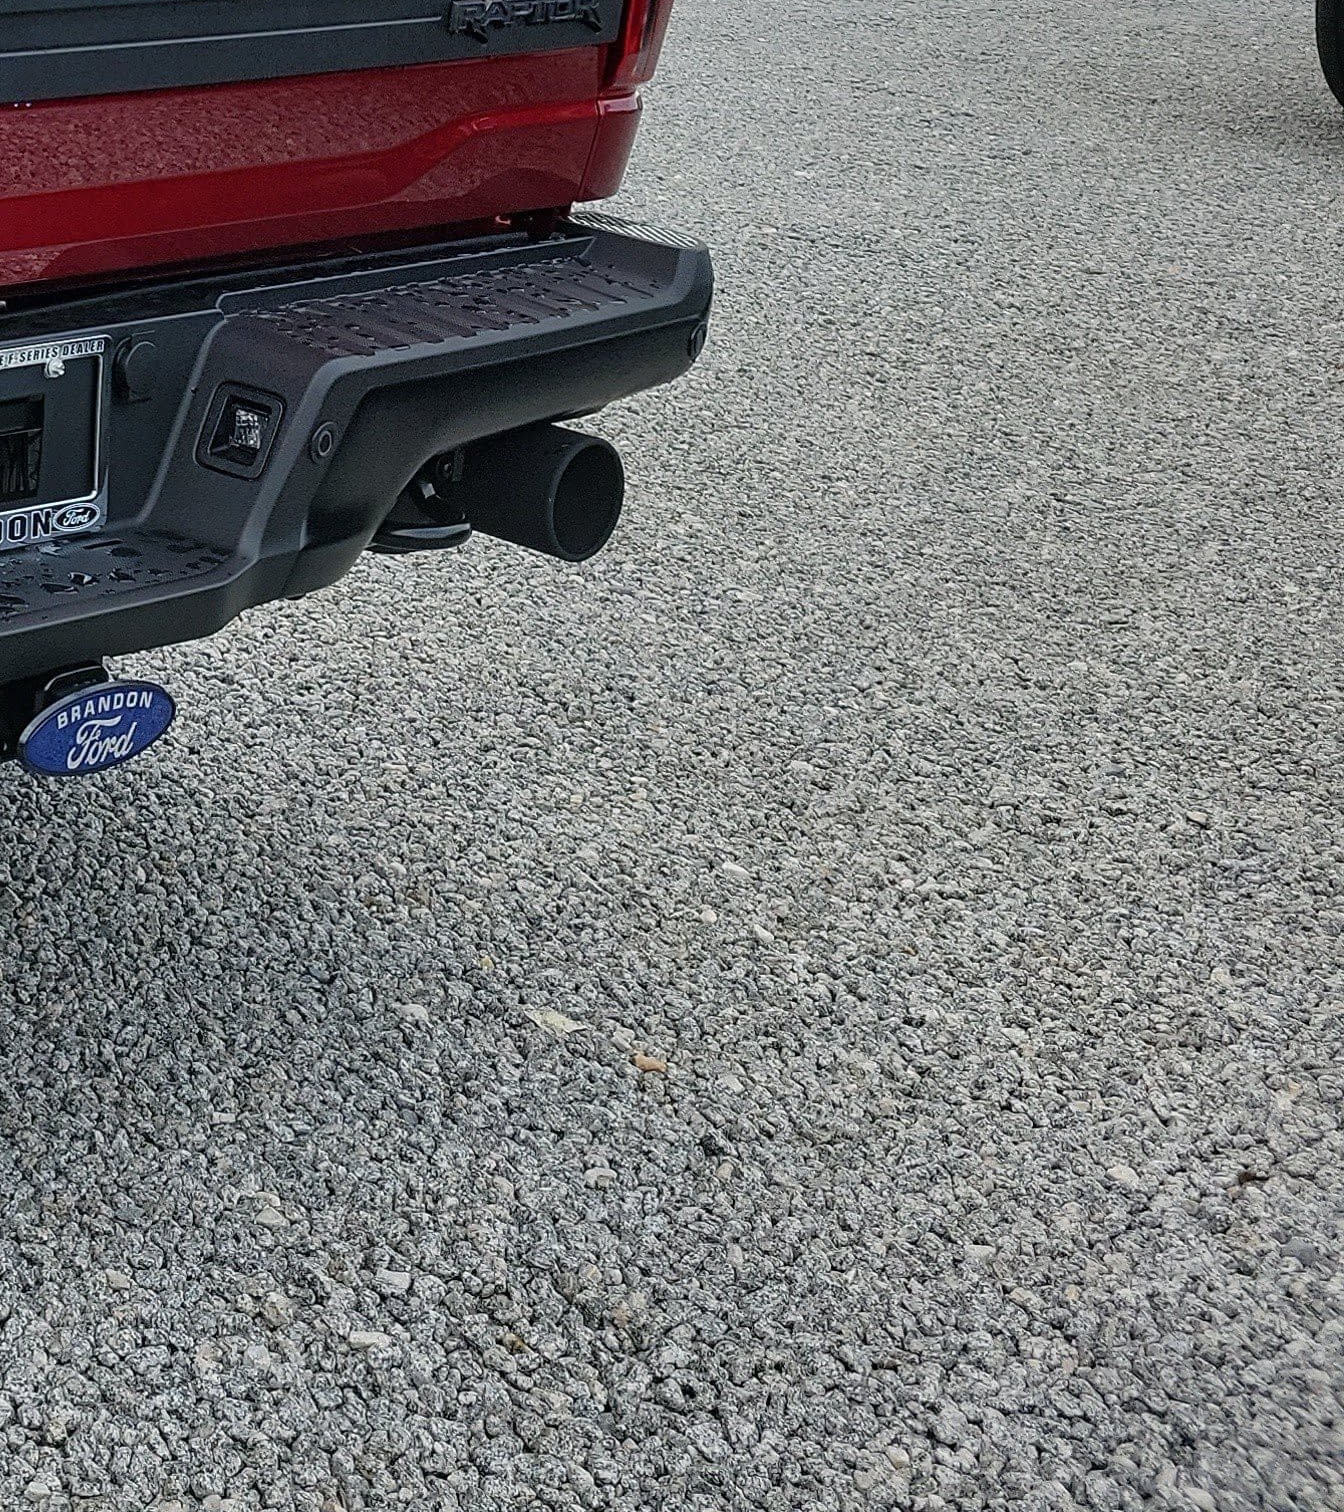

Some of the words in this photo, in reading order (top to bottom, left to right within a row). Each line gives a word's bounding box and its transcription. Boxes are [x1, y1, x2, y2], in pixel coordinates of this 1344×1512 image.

[62, 339, 105, 356] DEALER
[62, 506, 93, 526] Ford
[56, 691, 154, 729] BRANDON
[67, 715, 138, 769] Ford
